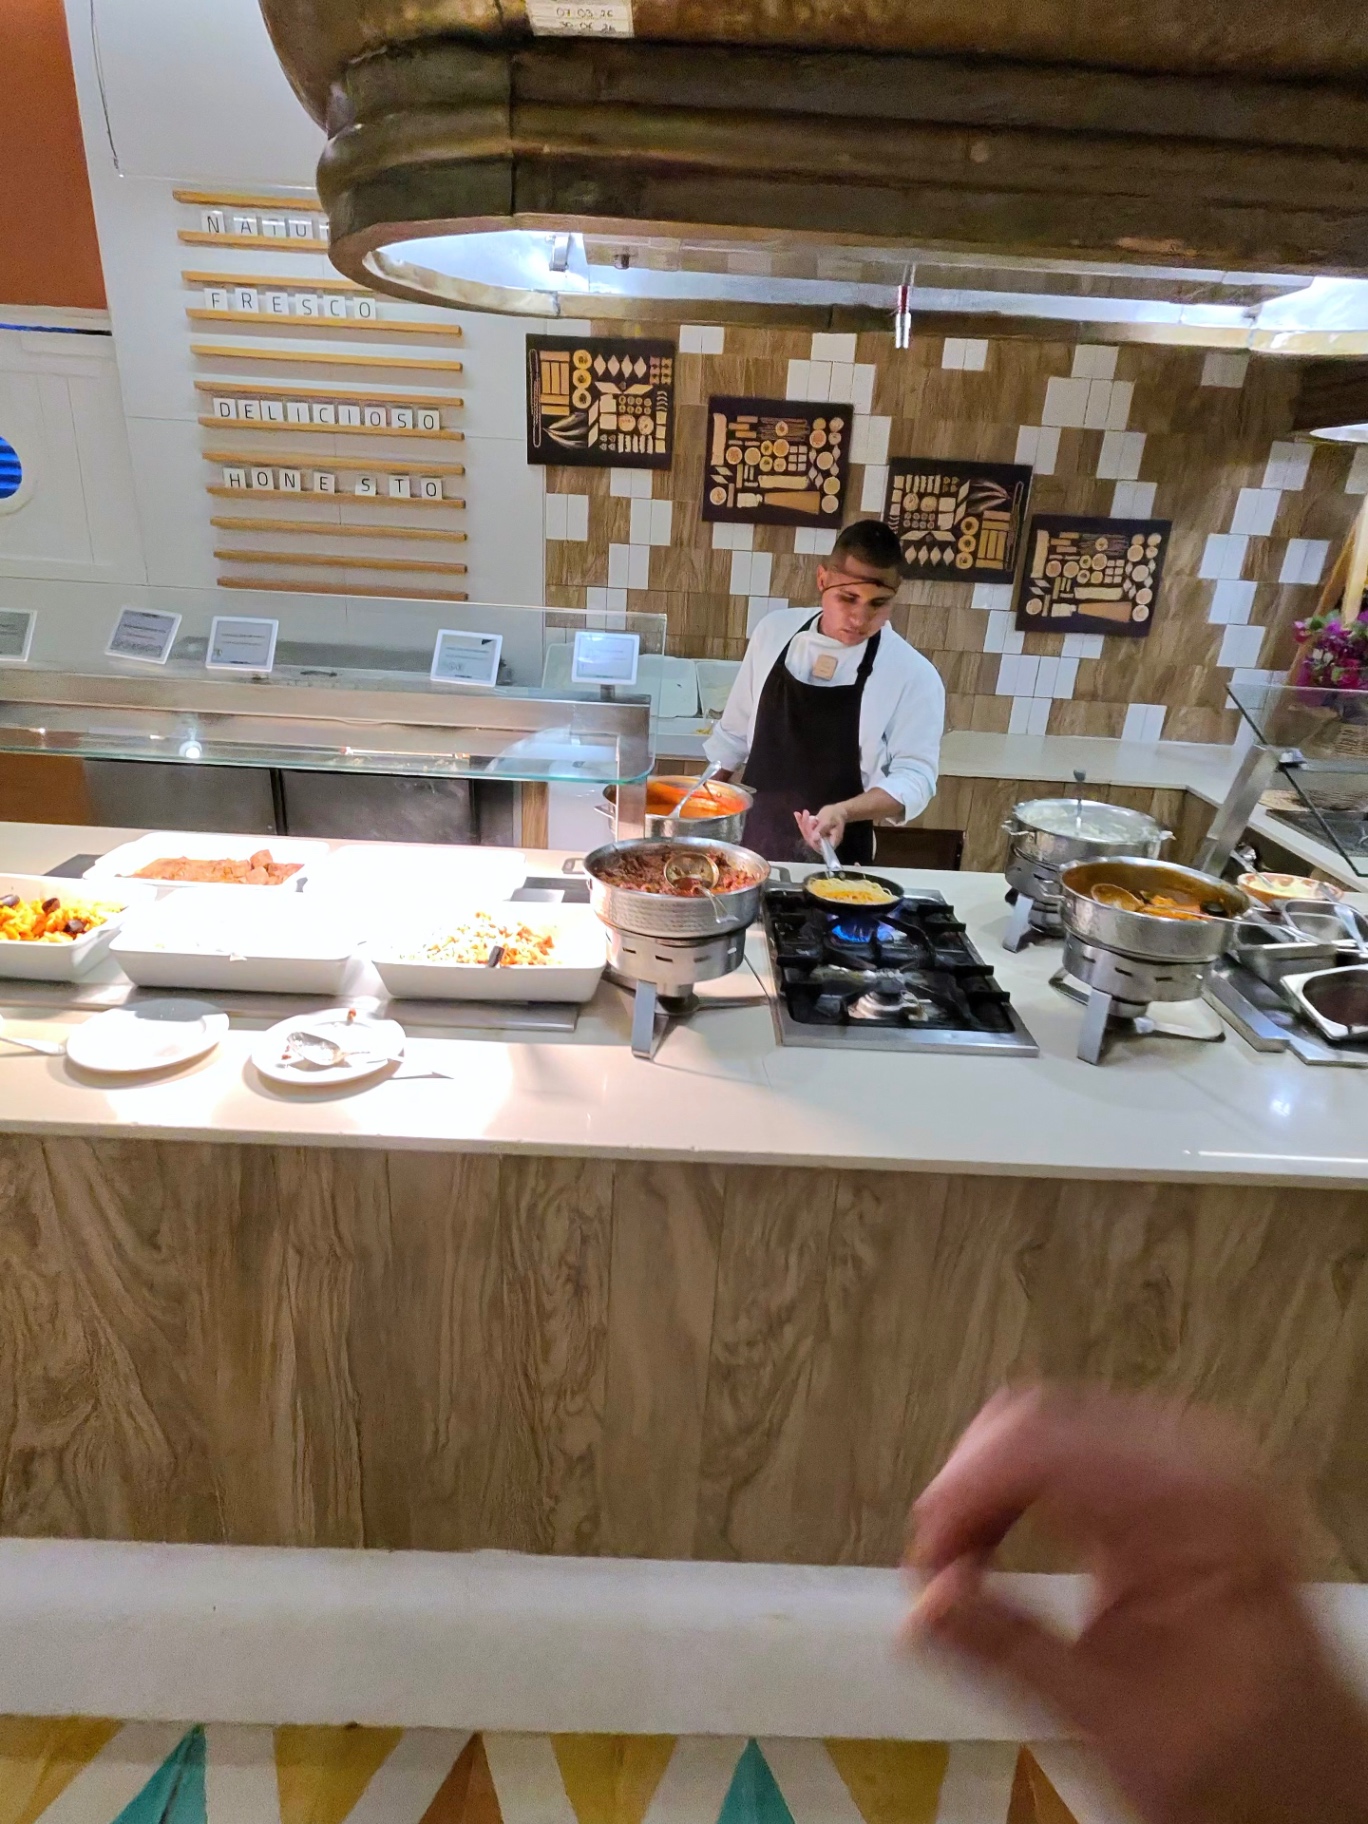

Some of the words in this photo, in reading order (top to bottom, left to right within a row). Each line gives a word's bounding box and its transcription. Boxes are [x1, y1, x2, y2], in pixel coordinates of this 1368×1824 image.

[207, 214, 330, 238] NATU
[211, 293, 371, 318] FRESCO
[219, 402, 435, 430] DELICIOSO
[229, 471, 438, 498] HONESTO
